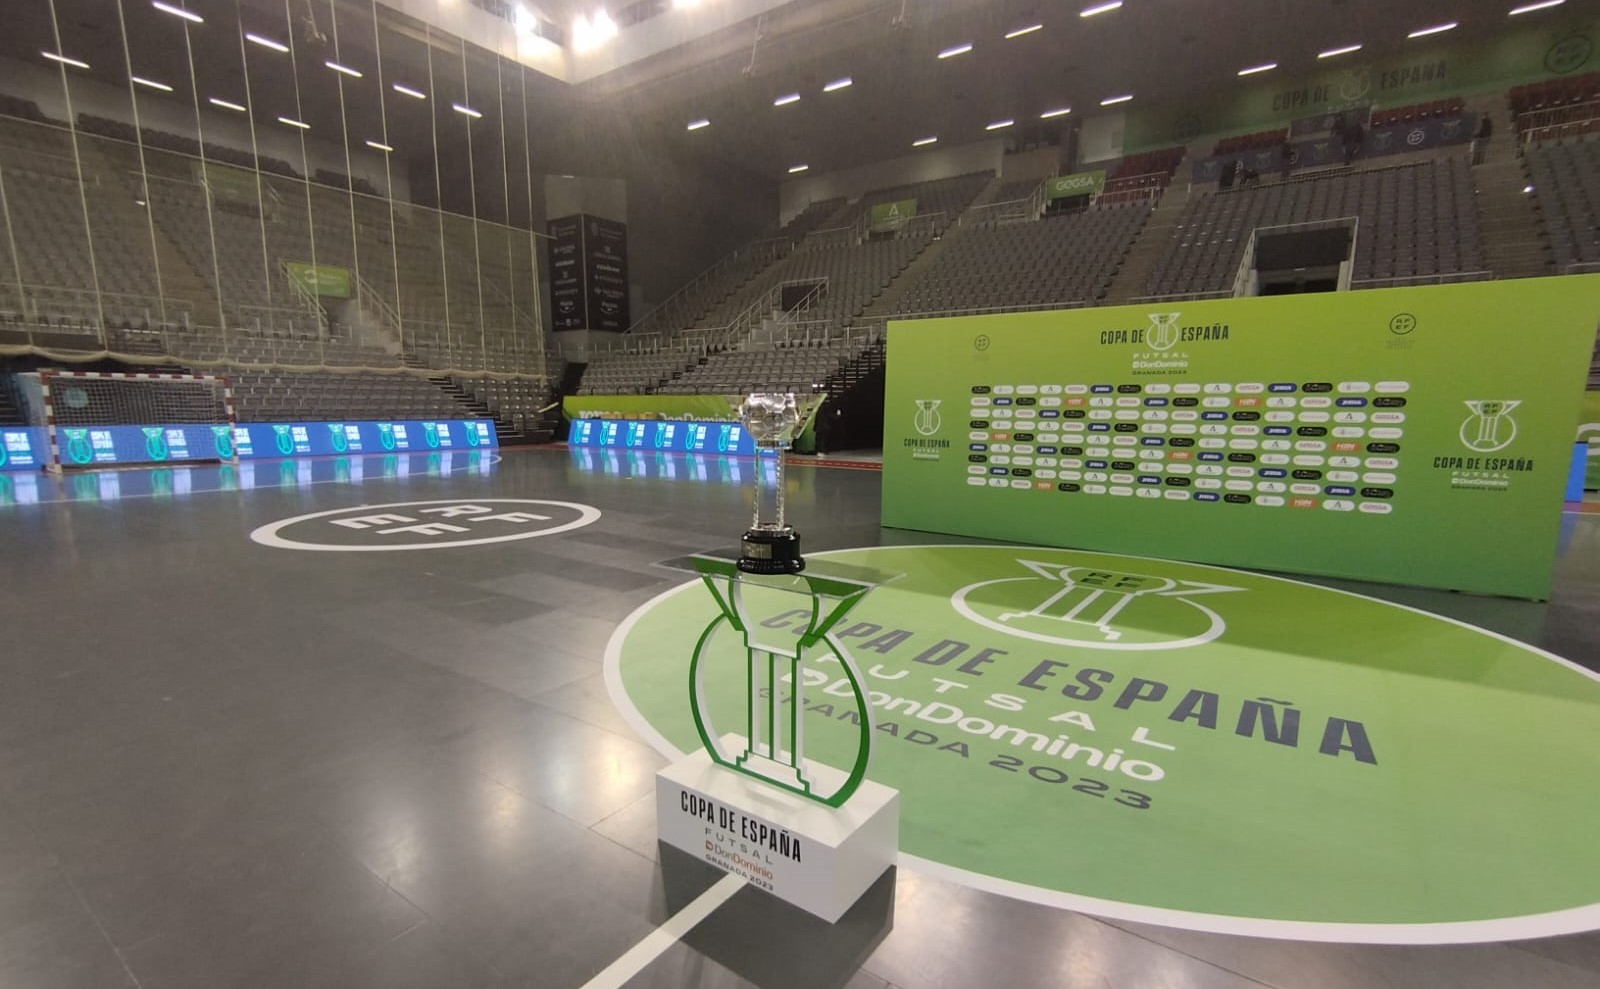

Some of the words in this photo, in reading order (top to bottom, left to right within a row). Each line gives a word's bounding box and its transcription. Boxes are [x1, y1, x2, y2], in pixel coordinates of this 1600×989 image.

[1100, 330, 1127, 344] COPA
[1131, 329, 1144, 343] DE
[1181, 323, 1229, 341] ESPAÑA
[1132, 352, 1189, 360] FUTSAL
[903, 439, 918, 447] COPA
[1433, 456, 1462, 468] COPA
[1466, 458, 1480, 469] DE
[1484, 457, 1533, 471] ESPAÑA
[911, 639, 1009, 676] DE
[1017, 659, 1378, 766] ESPAÑA
[823, 678, 1165, 781] DonDominio
[988, 753, 1153, 810] 2023
[681, 790, 715, 824] COPA
[719, 806, 736, 833] DE
[741, 816, 802, 863] ESPAÑA
[705, 827, 774, 866] FUTSAL
[714, 844, 774, 880] DonDominio
[705, 853, 748, 879] GRANADA
[749, 875, 774, 892] 2023
